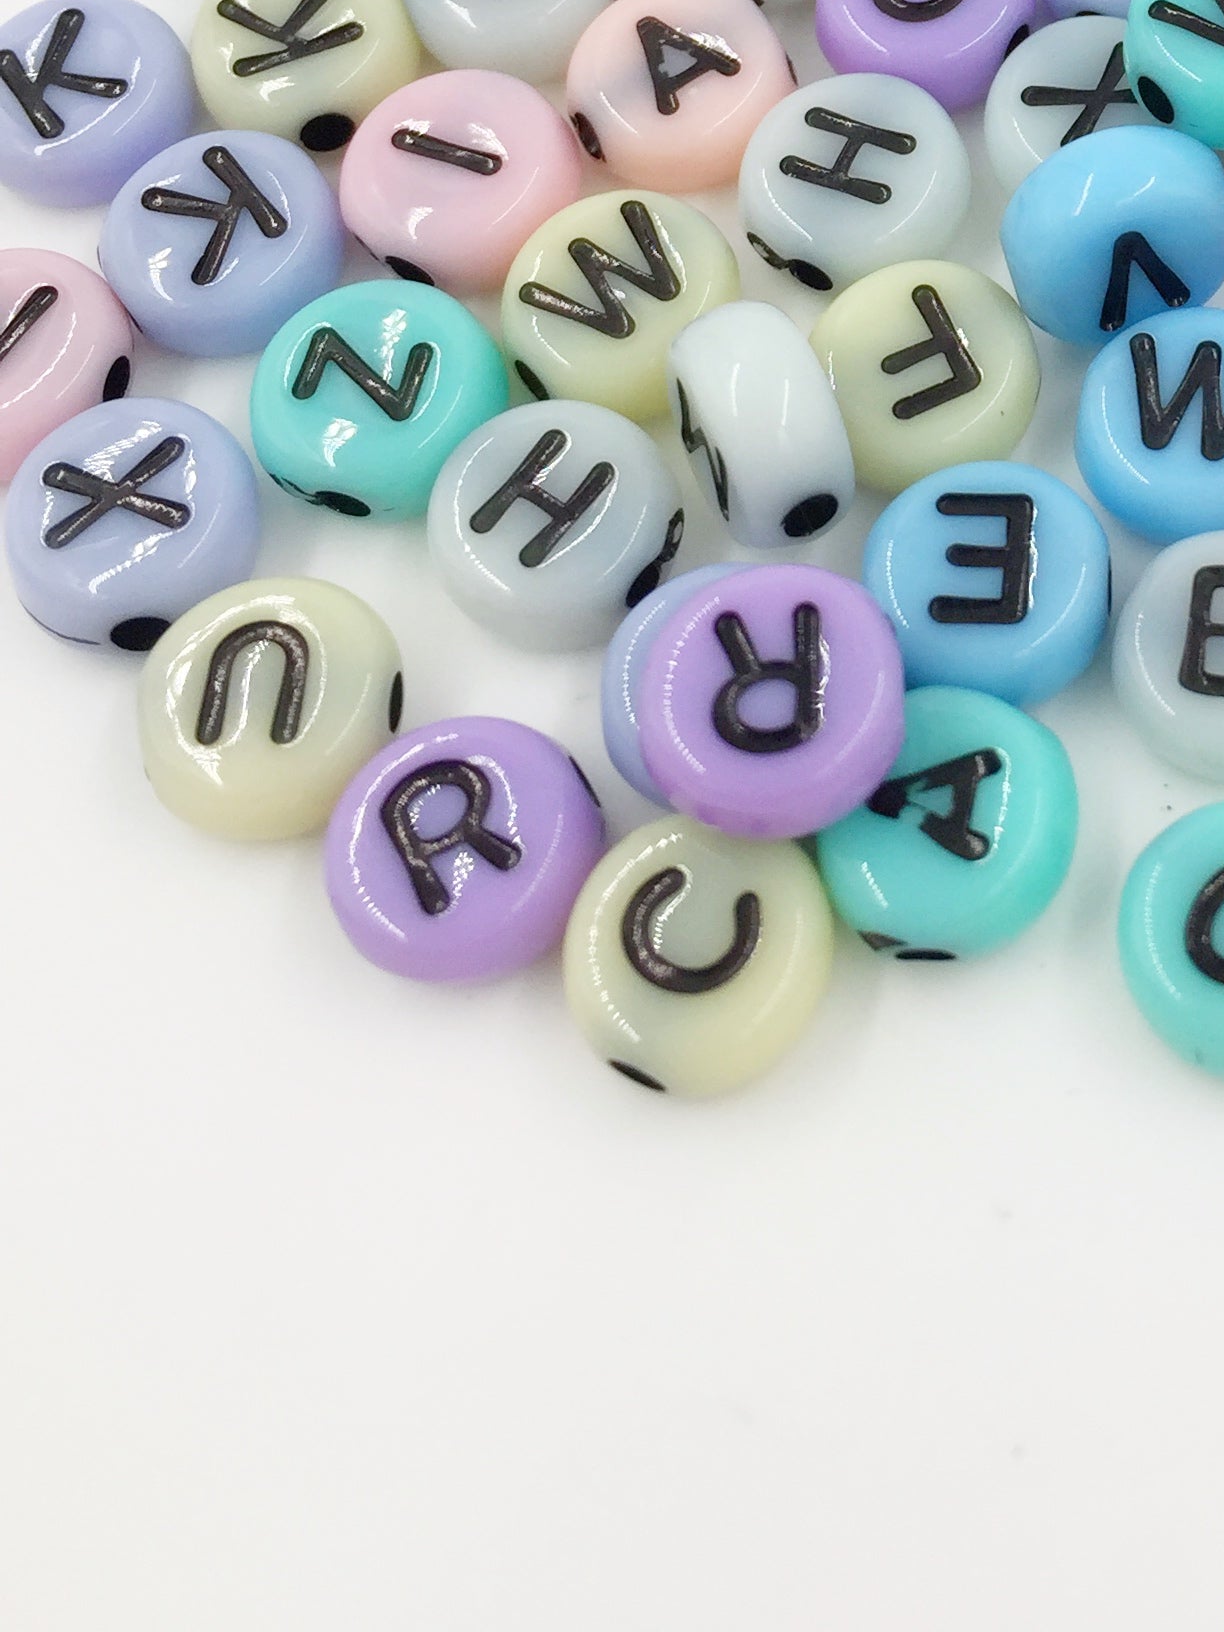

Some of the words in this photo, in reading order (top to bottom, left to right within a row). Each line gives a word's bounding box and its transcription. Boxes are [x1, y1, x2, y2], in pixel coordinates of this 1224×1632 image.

[0, 8, 129, 140] K
[636, 16, 741, 116] A
[1020, 41, 1139, 148] X
[140, 145, 288, 286] K
[778, 106, 917, 205] H
[518, 200, 681, 340] W
[1098, 230, 1191, 333] V
[880, 284, 982, 421] F
[42, 436, 191, 549] X
[469, 429, 615, 569] H
[927, 492, 1035, 625] E
[195, 620, 310, 746] U
[711, 602, 824, 755] R
[379, 759, 522, 916] R
[863, 748, 1003, 862] A
[620, 866, 761, 996] C
